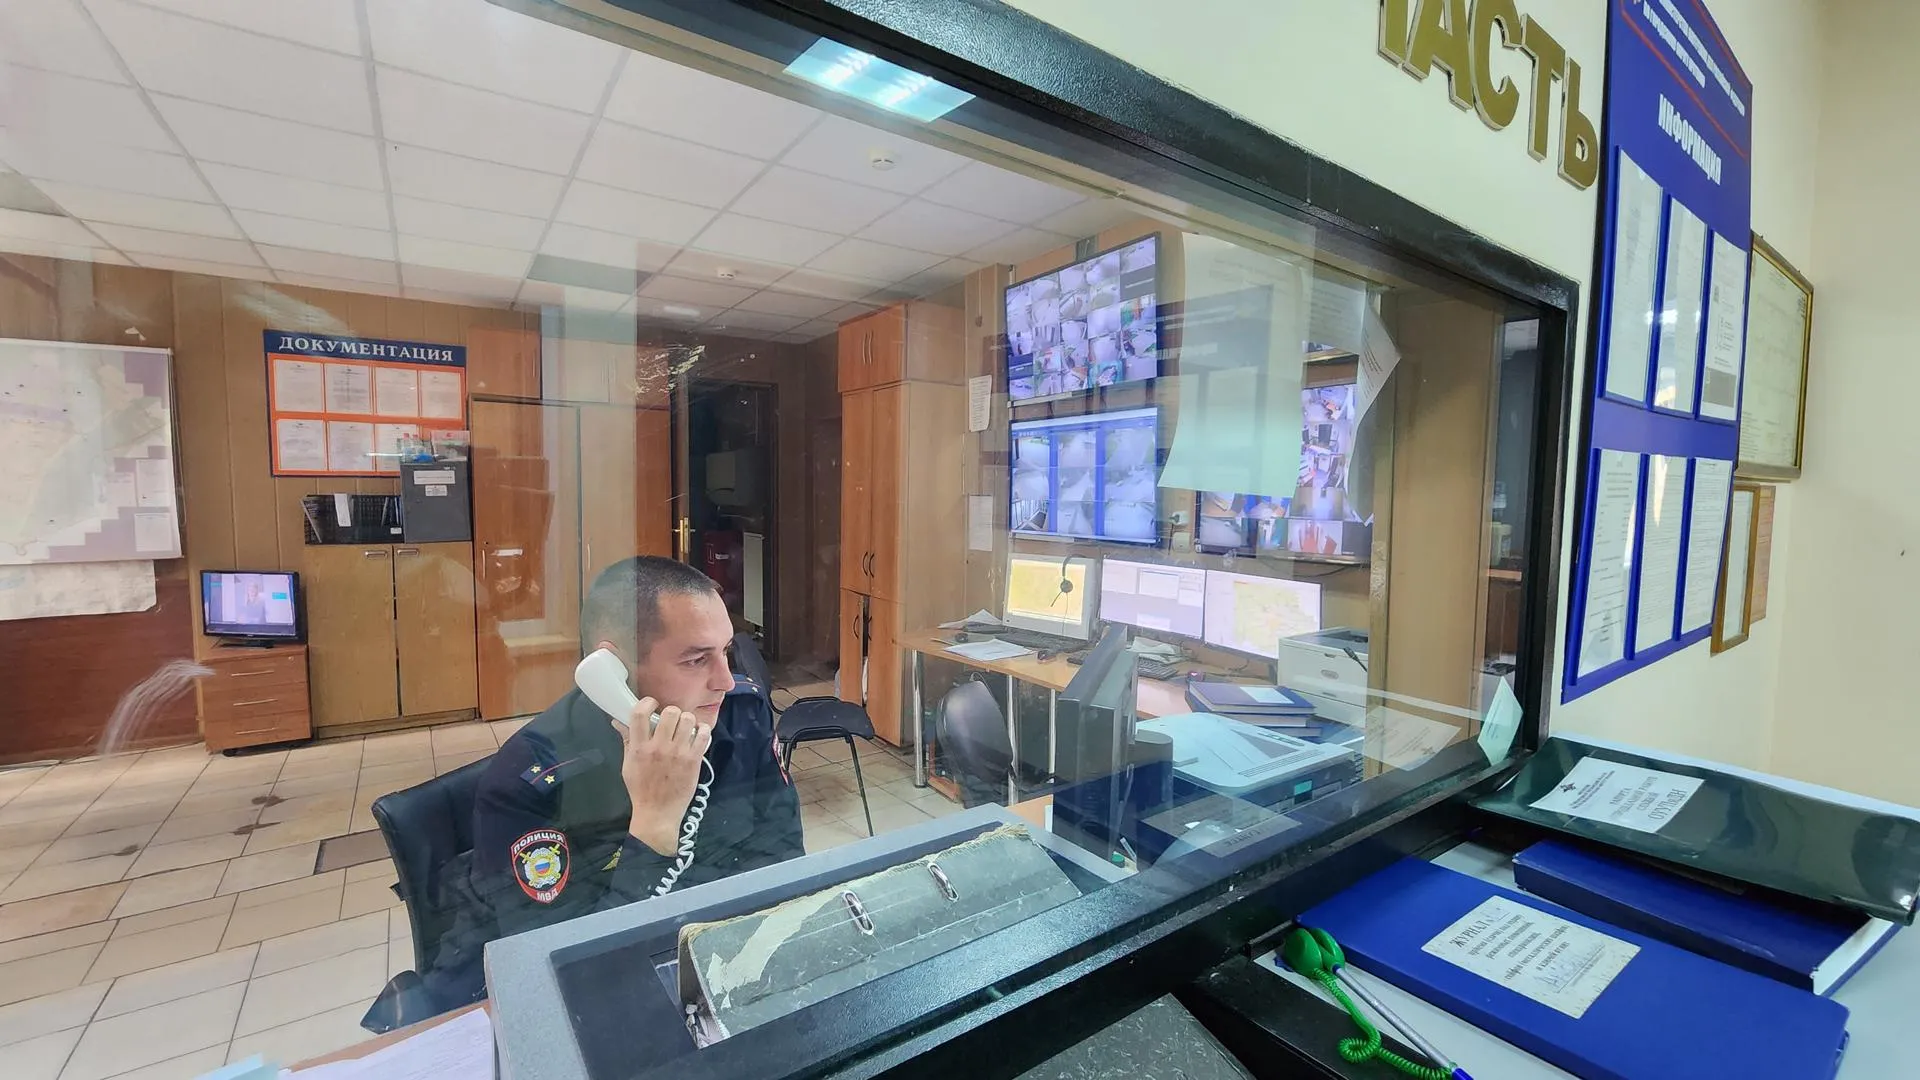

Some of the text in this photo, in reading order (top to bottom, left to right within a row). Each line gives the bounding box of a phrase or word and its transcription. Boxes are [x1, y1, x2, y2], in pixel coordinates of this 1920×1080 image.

[1658, 93, 1722, 186] ИНФОРМАЦИЯ
[278, 336, 454, 362] ДОКУМЕНТАЦИЯ
[513, 832, 564, 854] ПОЛИЦИЯ
[536, 887, 559, 901] МВД
[1449, 920, 1490, 948] ЖУРНАЛ
